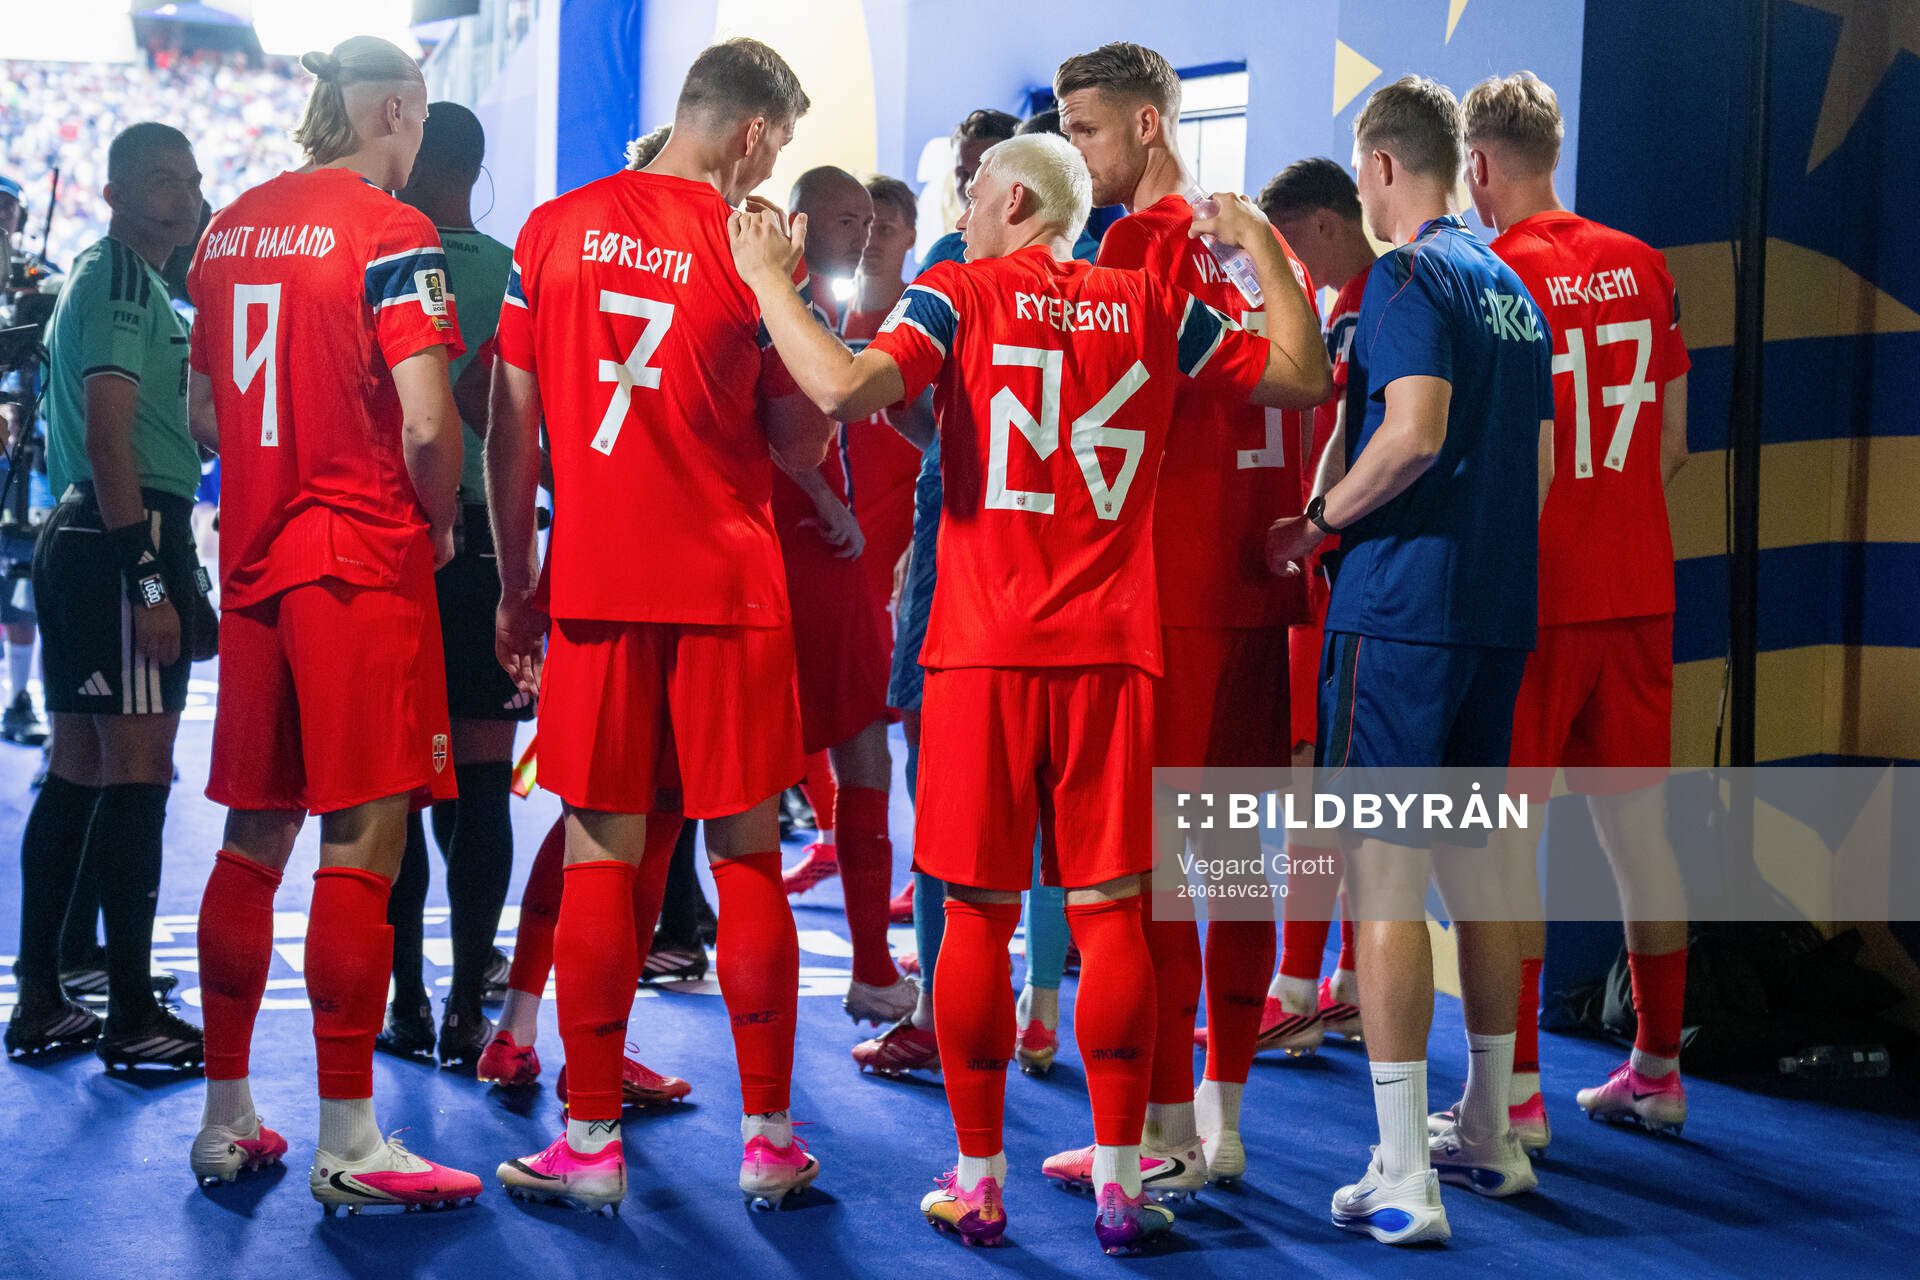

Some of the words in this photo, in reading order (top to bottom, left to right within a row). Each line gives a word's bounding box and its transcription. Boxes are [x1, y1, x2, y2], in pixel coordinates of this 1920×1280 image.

[203, 226, 254, 263] BRAUT
[254, 224, 336, 258] HAALAND
[582, 229, 692, 284] SØRLOTH
[1545, 266, 1639, 307] HEGGEM
[232, 283, 282, 447] 9
[1015, 291, 1129, 333] RYERSON
[589, 289, 675, 457] 7
[1552, 318, 1657, 480] 17
[984, 343, 1151, 521] 26
